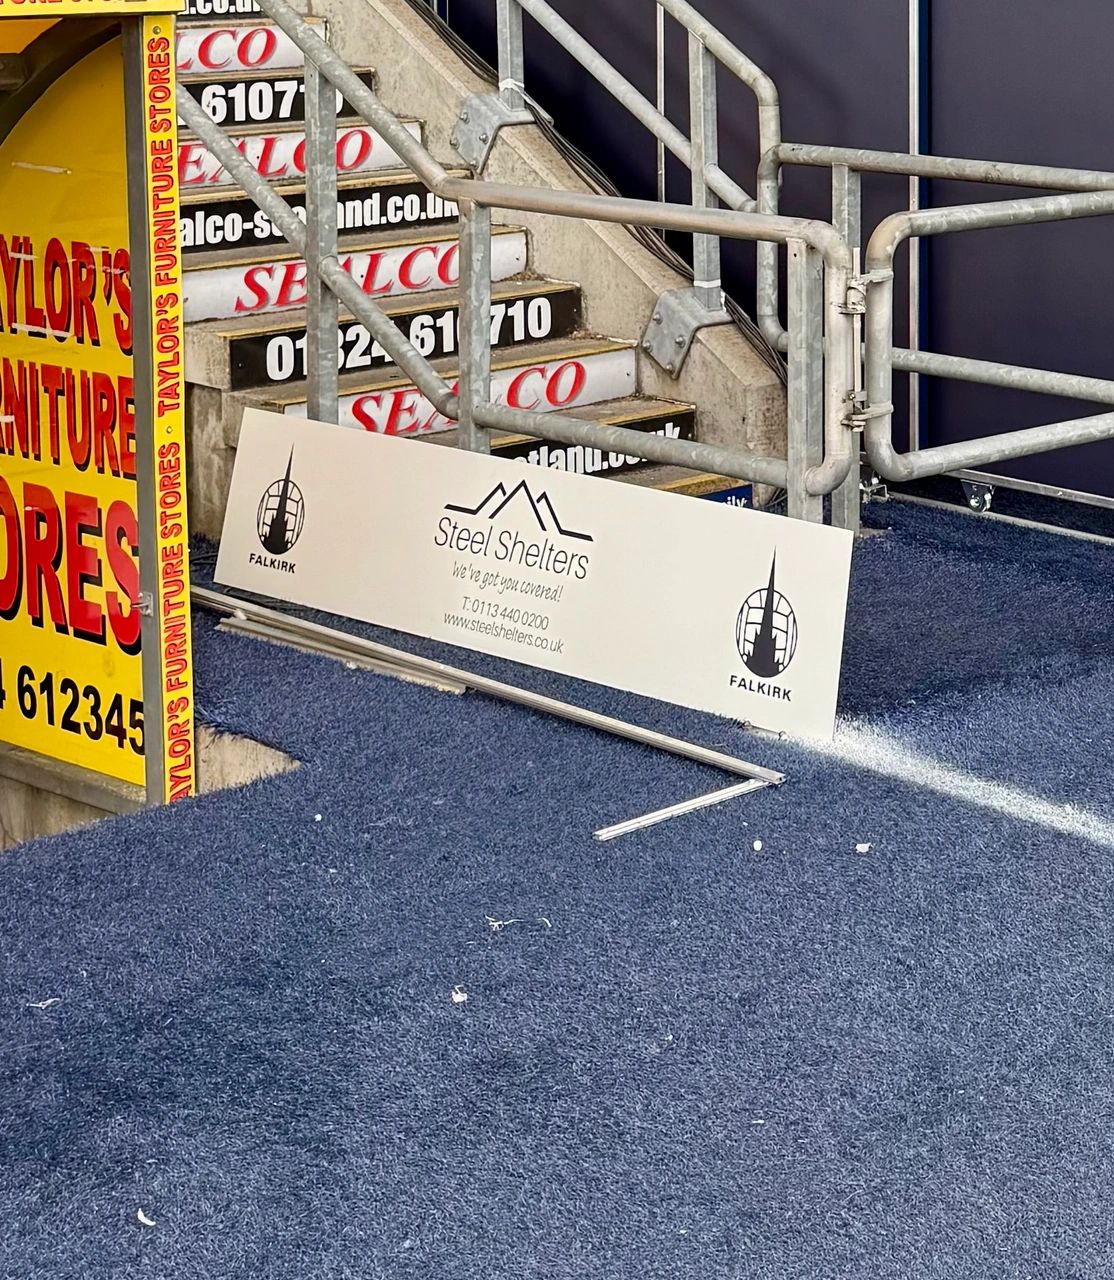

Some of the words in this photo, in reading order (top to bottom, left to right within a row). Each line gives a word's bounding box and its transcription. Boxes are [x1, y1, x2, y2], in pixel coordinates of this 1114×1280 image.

[147, 36, 172, 133] STORES
[151, 139, 178, 287] FURNITURE
[0, 234, 133, 356] YLOR'S
[156, 292, 180, 418] TAYLOR'S
[0, 357, 136, 480] NITURE
[158, 441, 182, 538] STORES
[249, 553, 296, 574] FALKIRK
[434, 516, 493, 557] Steel
[494, 530, 589, 580] Shelters
[452, 561, 480, 583] We've
[479, 571, 500, 590] got
[499, 576, 519, 595] you
[520, 581, 564, 603] covered!
[163, 542, 188, 694] FURNITURE
[444, 613, 564, 654] www.steelshelters.co.uk
[500, 607, 520, 624] 440
[521, 610, 549, 630] 0200
[729, 674, 792, 702] FALKIRK
[168, 697, 192, 803] AYLOR'S
